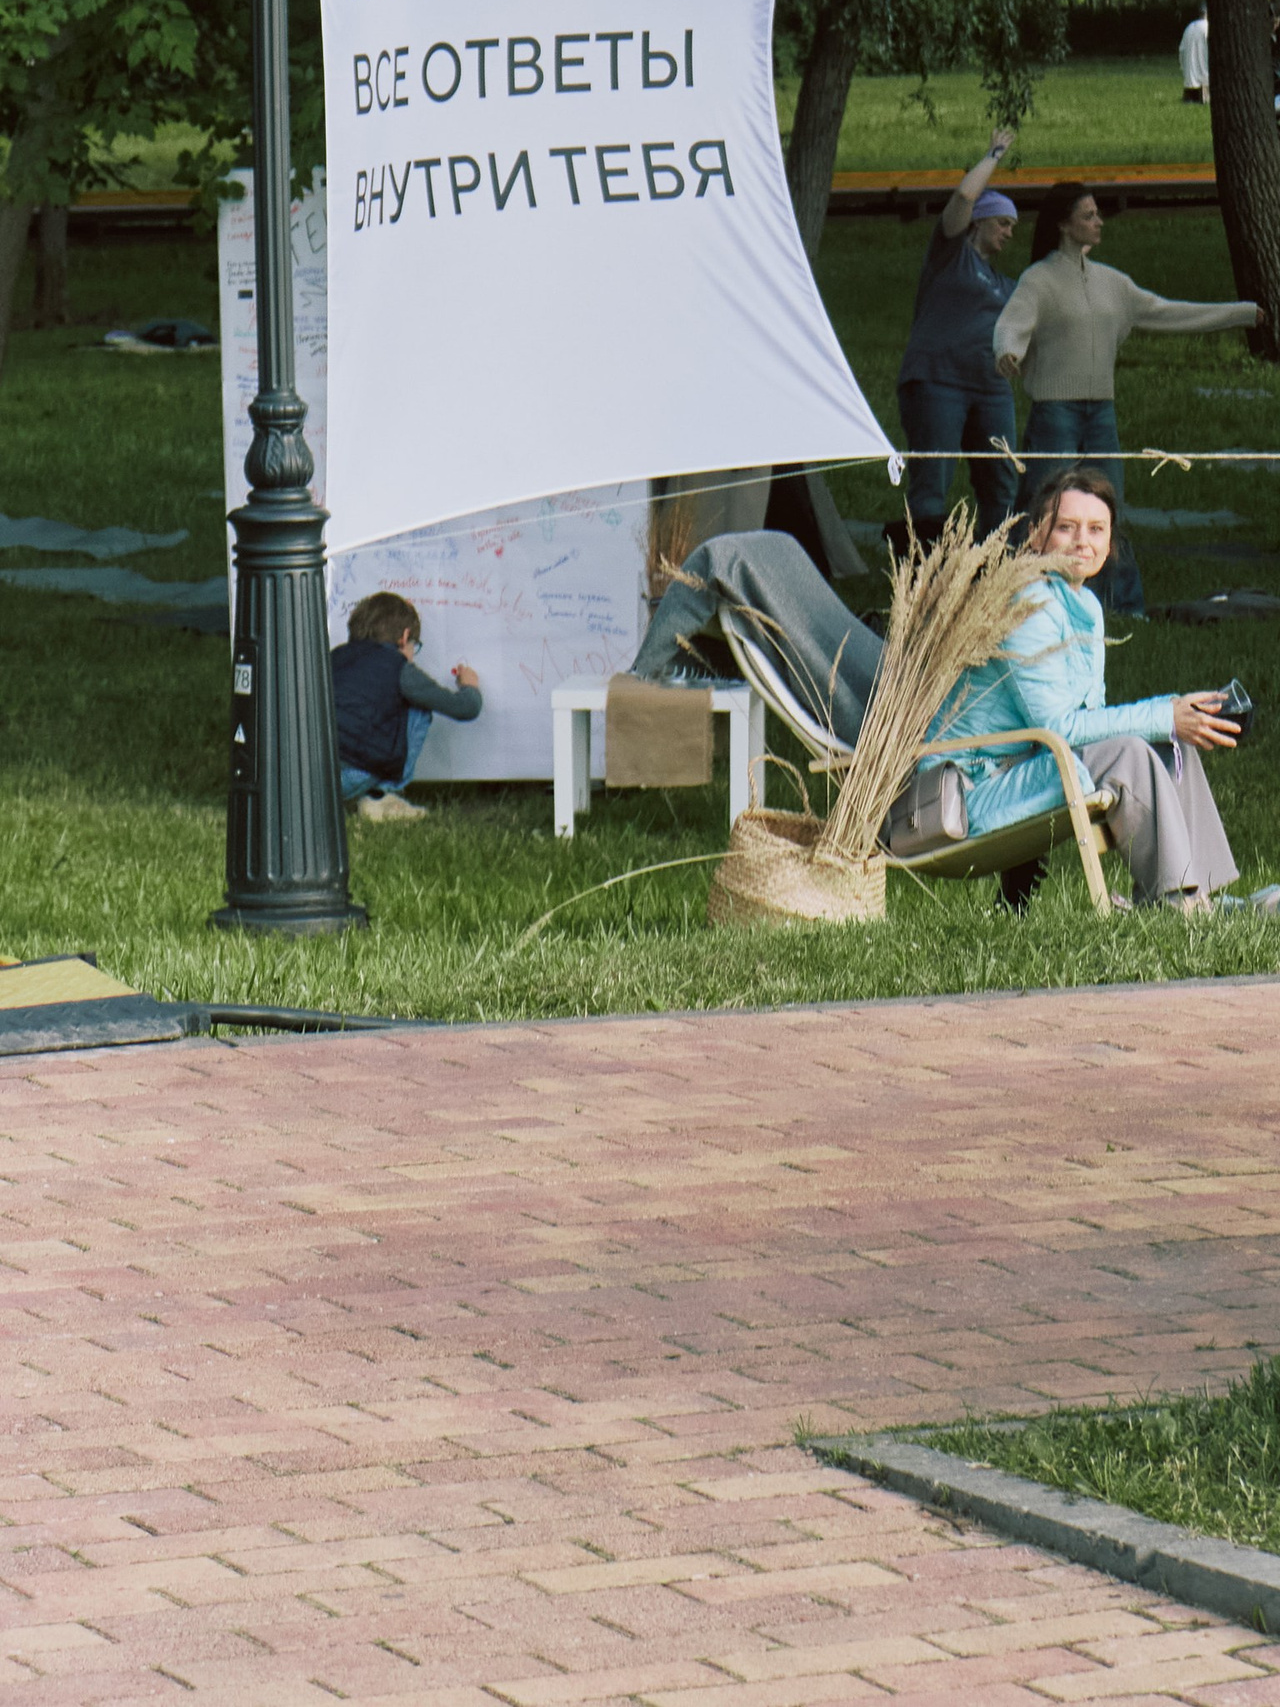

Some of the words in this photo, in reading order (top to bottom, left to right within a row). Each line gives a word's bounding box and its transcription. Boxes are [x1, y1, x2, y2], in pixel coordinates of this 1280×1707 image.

[353, 45, 410, 116] ВСЕ
[421, 28, 695, 104] ОТВЕТЫ
[353, 149, 538, 232] ВНУТРИ
[548, 139, 736, 206] ТЕБЯ
